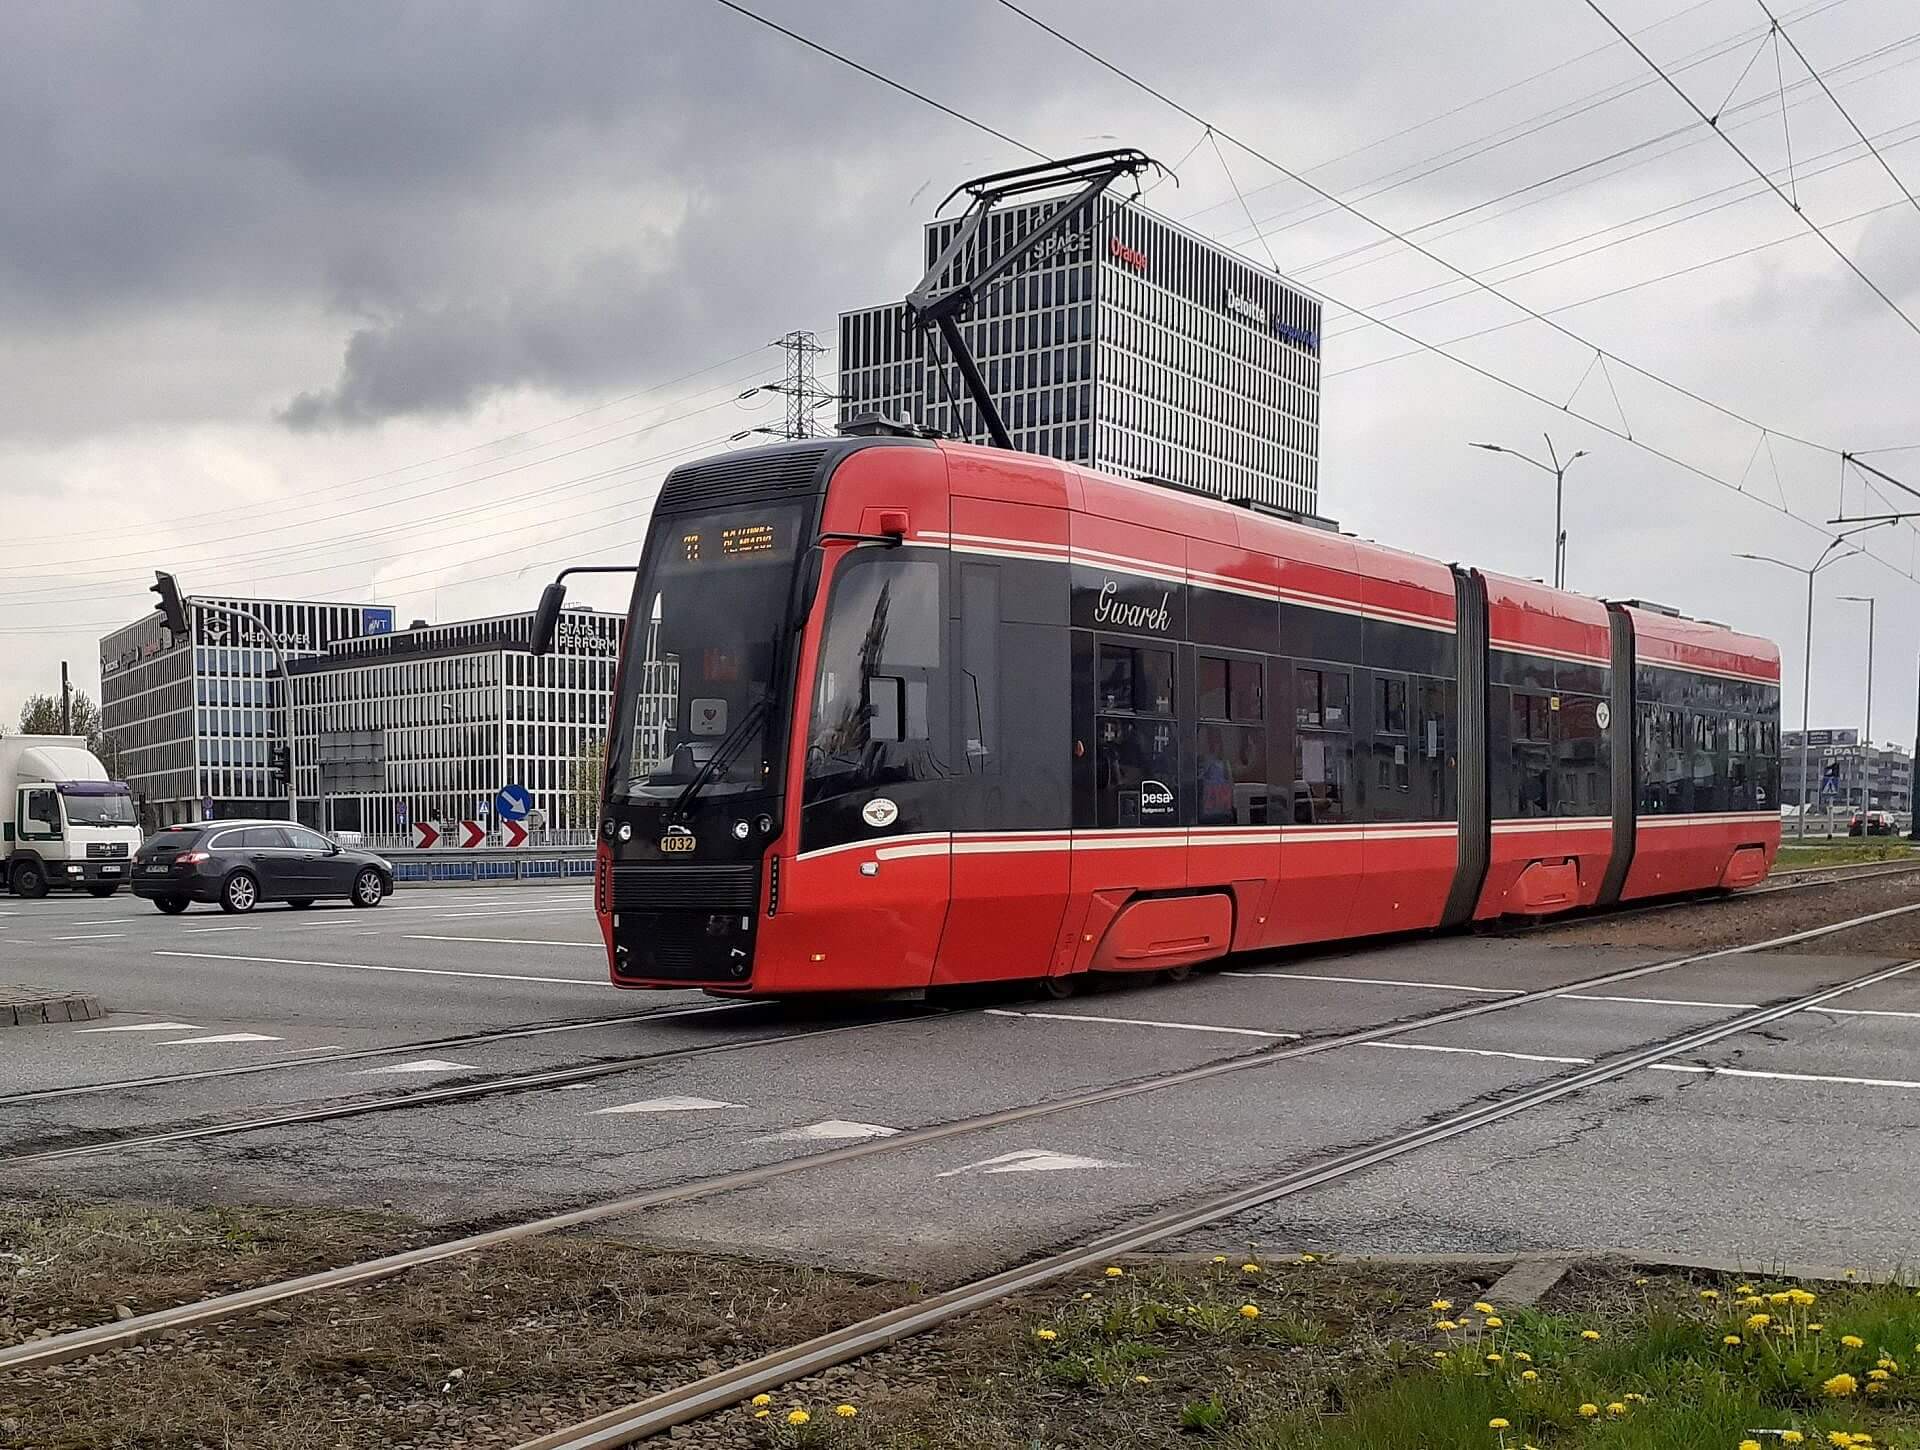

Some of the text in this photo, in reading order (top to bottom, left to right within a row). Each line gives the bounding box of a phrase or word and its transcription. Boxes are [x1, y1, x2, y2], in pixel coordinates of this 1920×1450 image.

[1033, 231, 1091, 259] SPACE
[1111, 235, 1148, 272] Orange
[1227, 288, 1266, 325] Deloitte
[1095, 575, 1172, 631] Gwarek
[559, 623, 595, 636] STATS
[559, 635, 616, 651] PERFORM
[1823, 747, 1860, 756] OPAL
[1141, 793, 1170, 807] pesa
[663, 838, 693, 850] 1032
